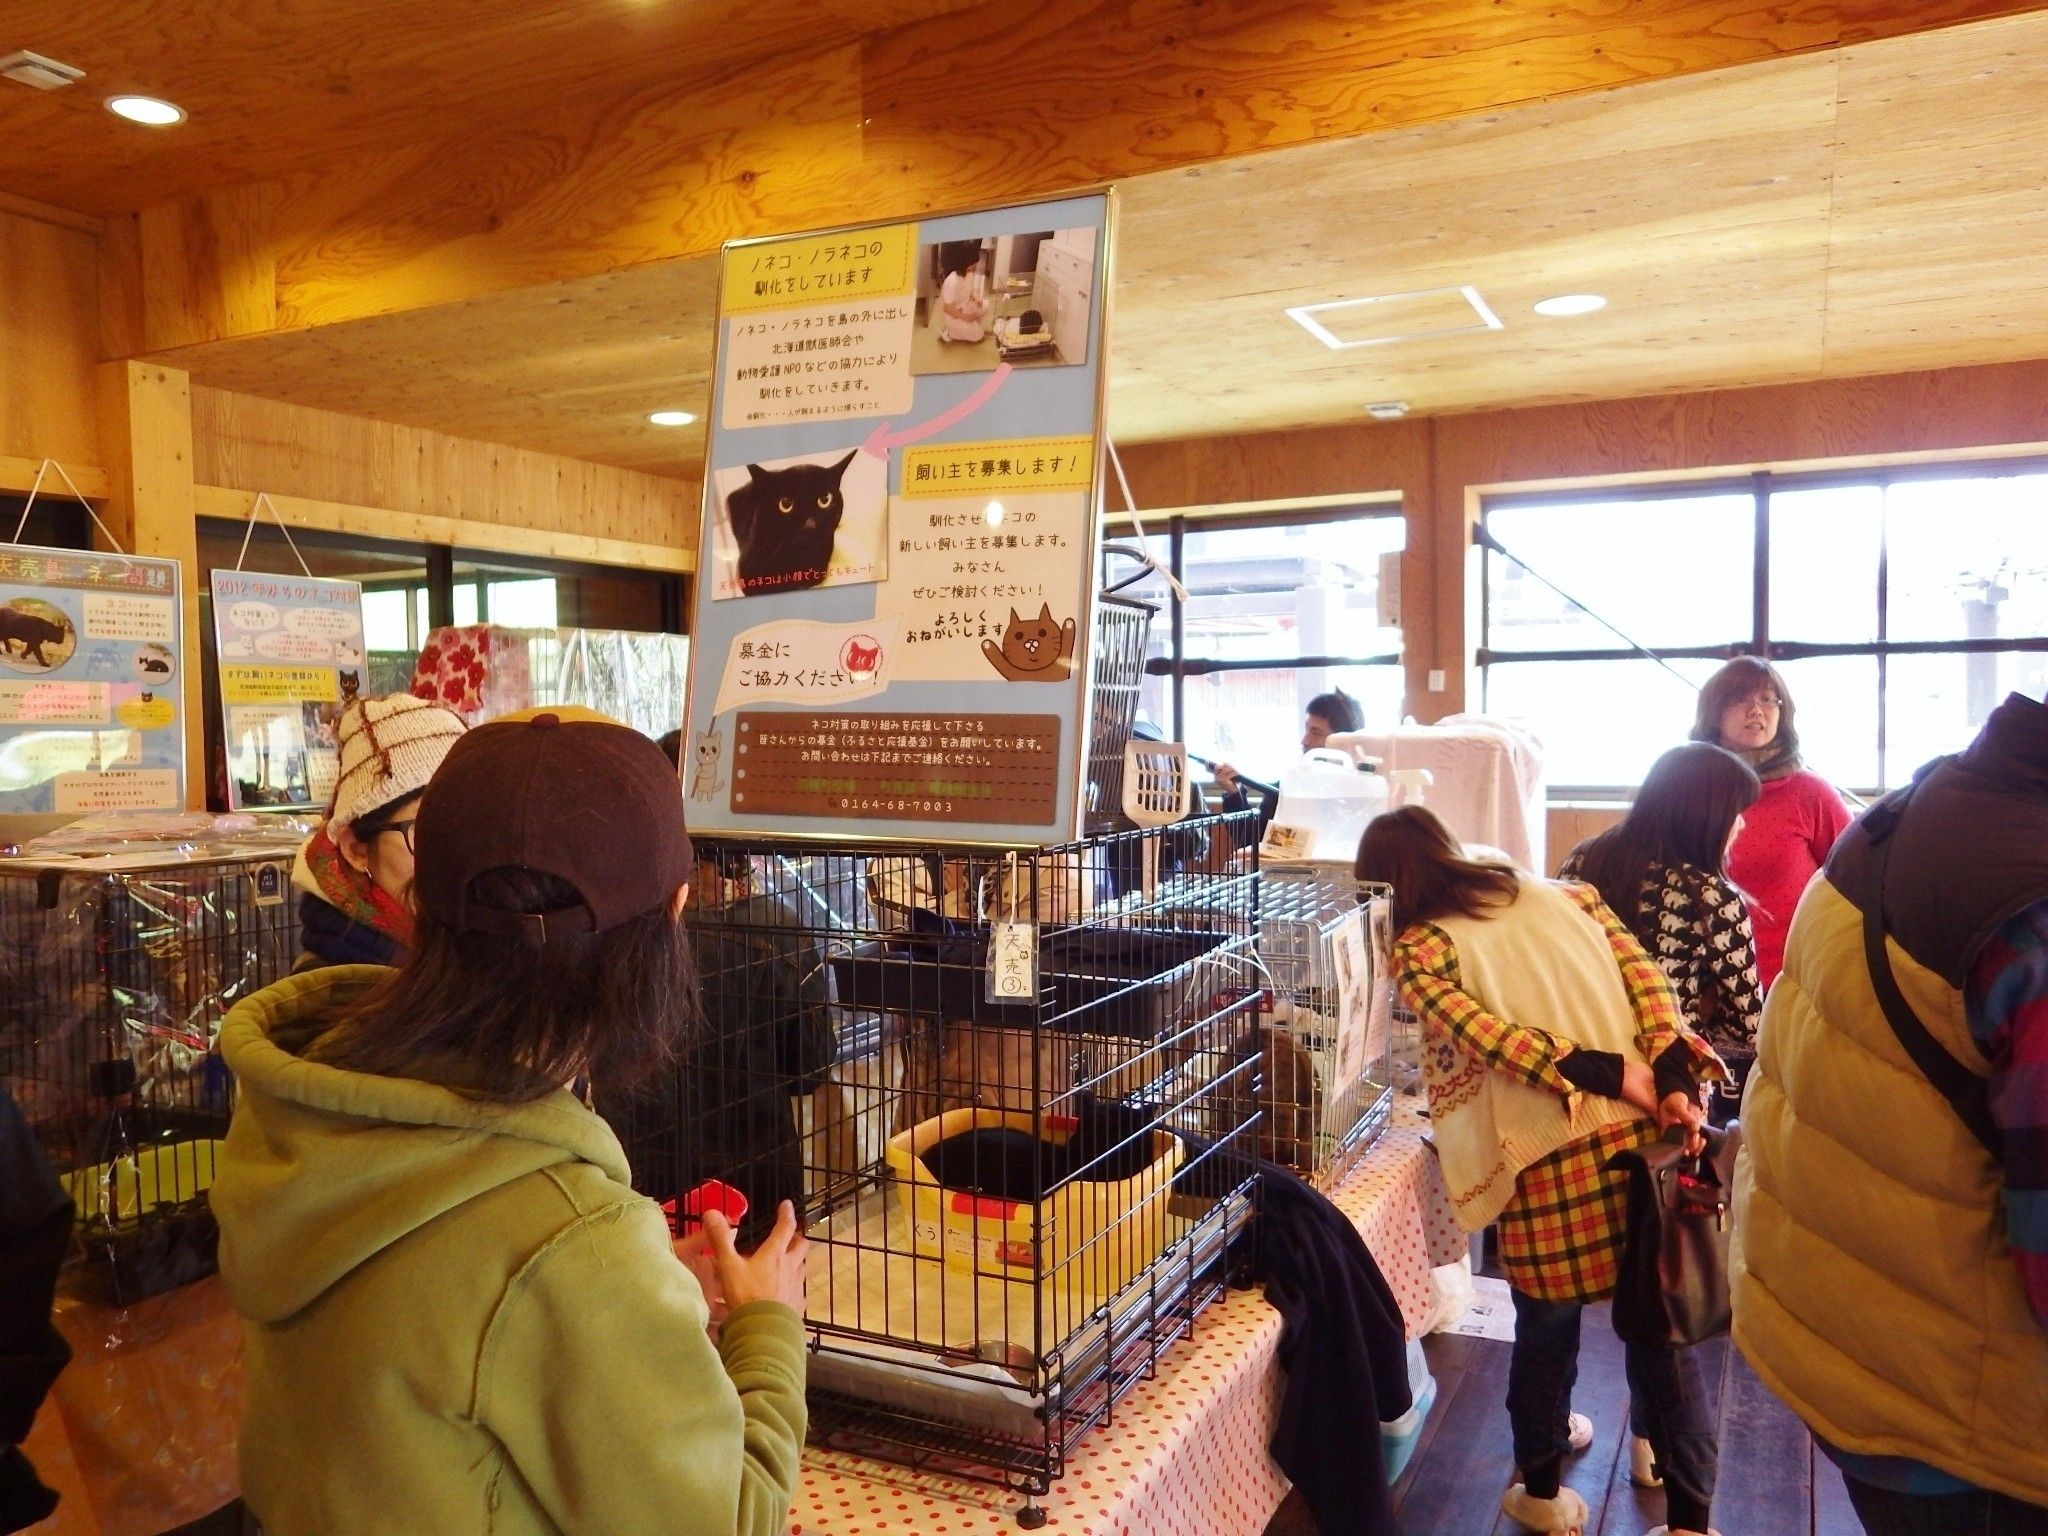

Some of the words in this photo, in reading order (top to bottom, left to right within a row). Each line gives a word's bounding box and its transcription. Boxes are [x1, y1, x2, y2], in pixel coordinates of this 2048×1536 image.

[751, 241, 883, 273] ノネコ・ノラネコの
[754, 267, 873, 296] 馴化をしています
[736, 308, 908, 336] ノネコ・ノラネコを島の外に出し
[771, 334, 865, 355] 北海道獣医師会や
[758, 378, 871, 400] 馴化をしていきます。
[929, 511, 1036, 527] 馴化させコの
[898, 534, 1068, 553] 新しい飼い主を募集します。
[953, 560, 1005, 574] みなさん
[935, 609, 987, 627] よろしく
[906, 622, 1004, 644] おねがいします
[738, 641, 790, 660] 募金に
[811, 719, 985, 732] ネコ対策の取り組みを応援して下さる
[801, 750, 992, 767] お問い合わせは下記までご連絡ください。
[841, 798, 953, 812] 0164-68-7003
